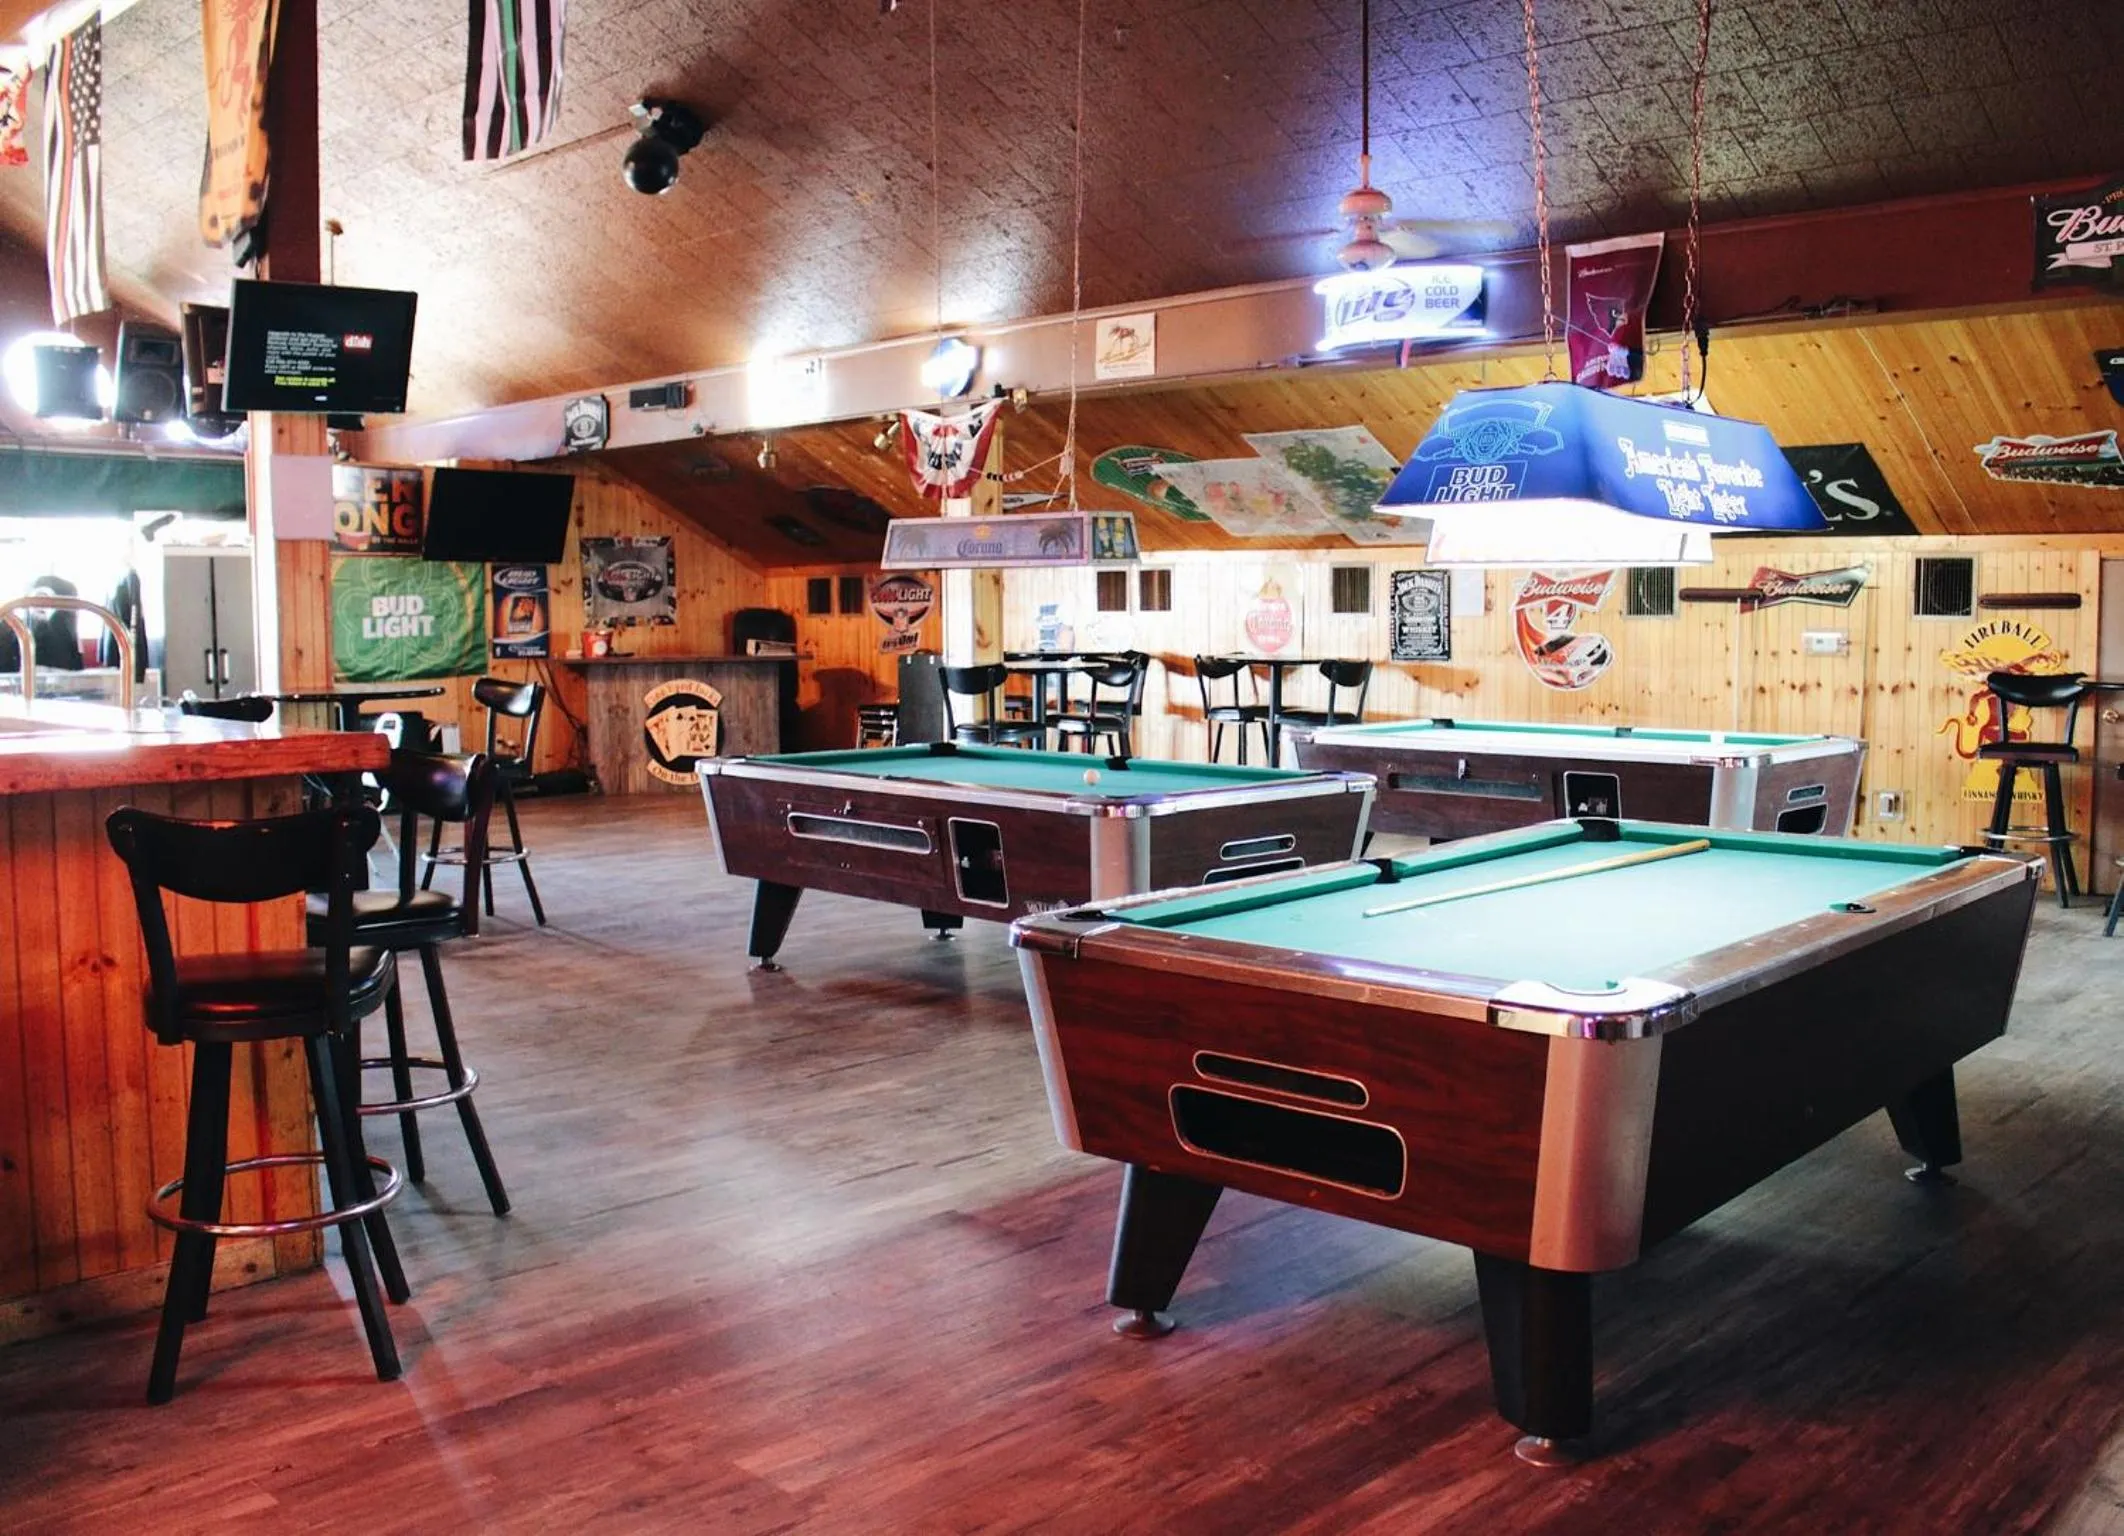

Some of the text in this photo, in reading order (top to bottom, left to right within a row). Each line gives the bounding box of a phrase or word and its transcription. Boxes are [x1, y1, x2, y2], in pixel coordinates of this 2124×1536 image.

[1425, 286, 1459, 297] COLD
[1425, 298, 1460, 309] BEER
[1450, 466, 1508, 486] BUD
[1434, 484, 1516, 502] LIGHT
[957, 539, 1003, 558] Corona
[899, 588, 931, 601] LIGHT
[1516, 578, 1611, 597] Budweiser
[1756, 579, 1852, 597] Budweiser
[372, 595, 424, 617] BUD
[1546, 603, 1570, 629] 4
[362, 615, 435, 639] LIGHT
[1964, 620, 2041, 648] FIREBALL
